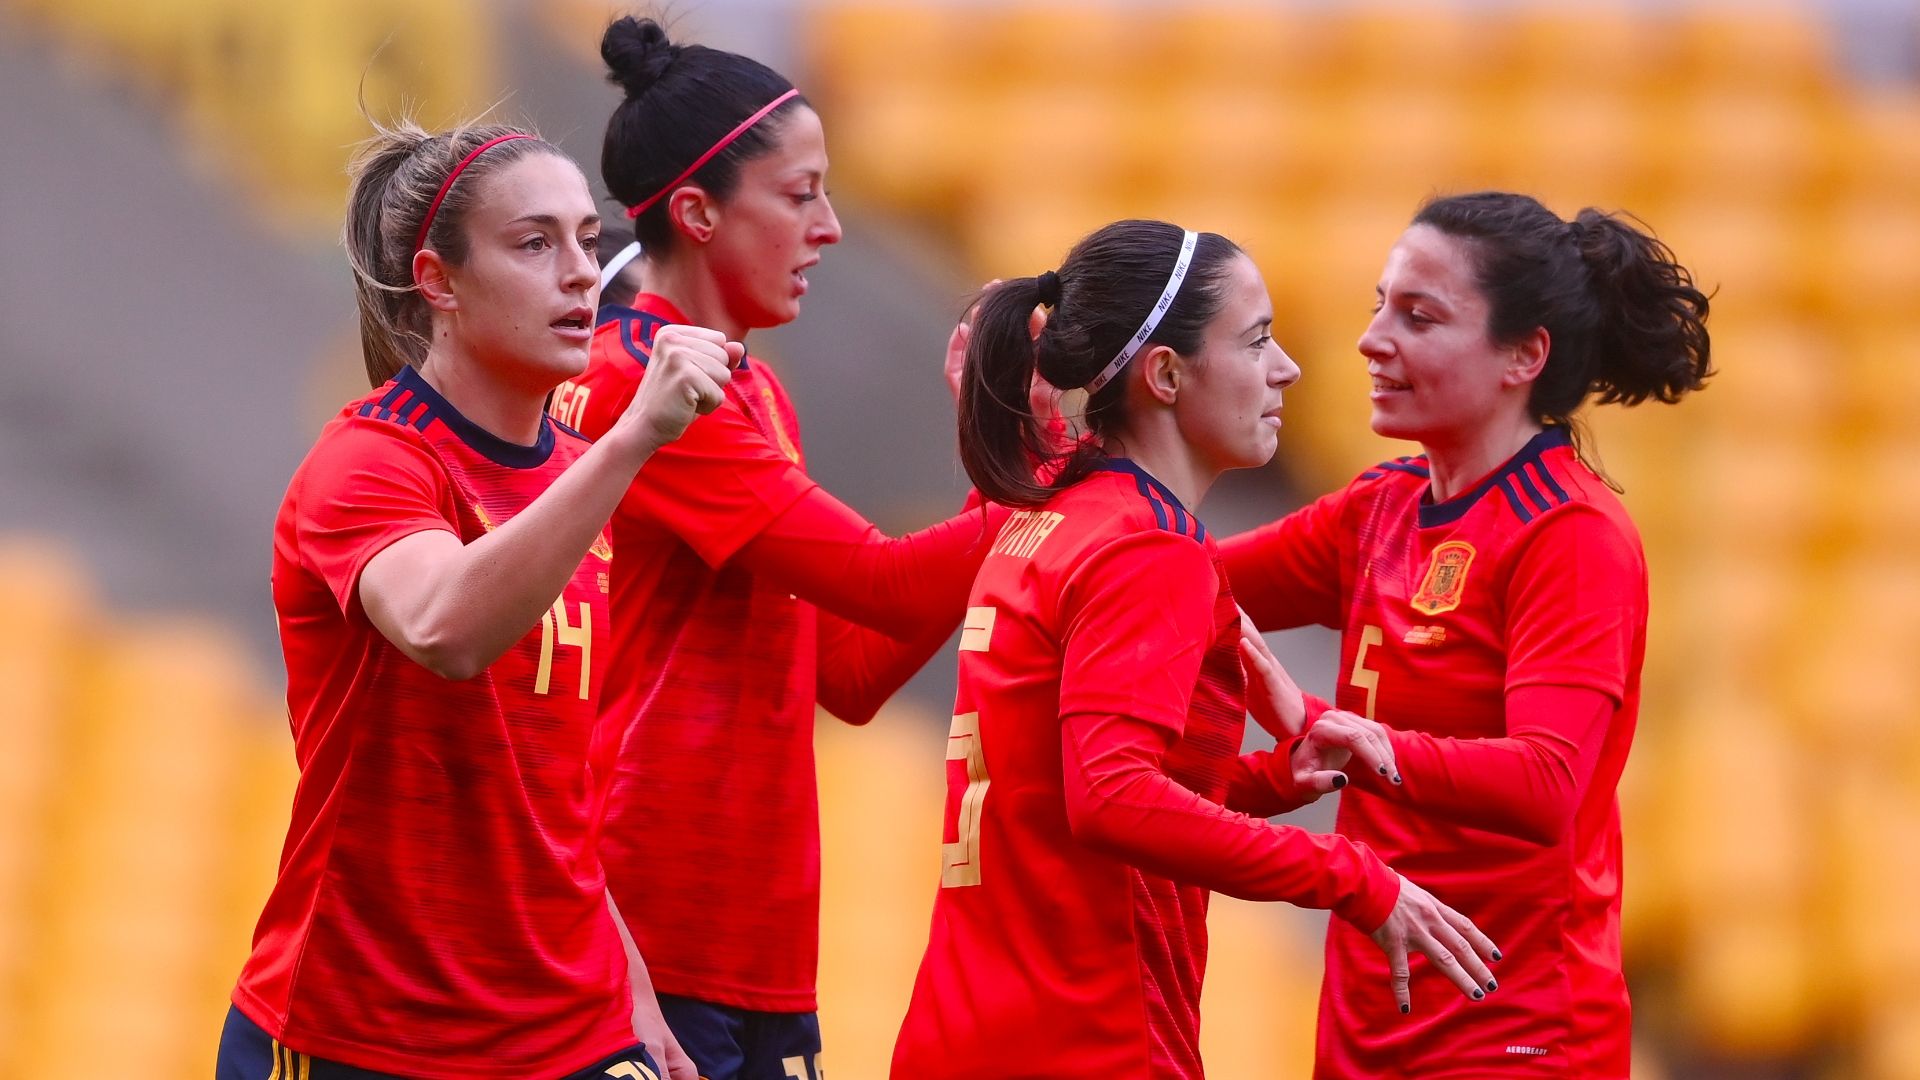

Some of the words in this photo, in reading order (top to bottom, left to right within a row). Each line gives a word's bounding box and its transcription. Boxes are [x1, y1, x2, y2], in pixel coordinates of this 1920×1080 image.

[1114, 350, 1131, 370] NIKE
[1136, 321, 1153, 343] NIKE
[1158, 292, 1173, 313] NIKE
[1175, 262, 1187, 280] NIKE
[534, 592, 592, 700] 14
[1350, 624, 1383, 721] 5
[1505, 1045, 1548, 1056] AEROREADY
